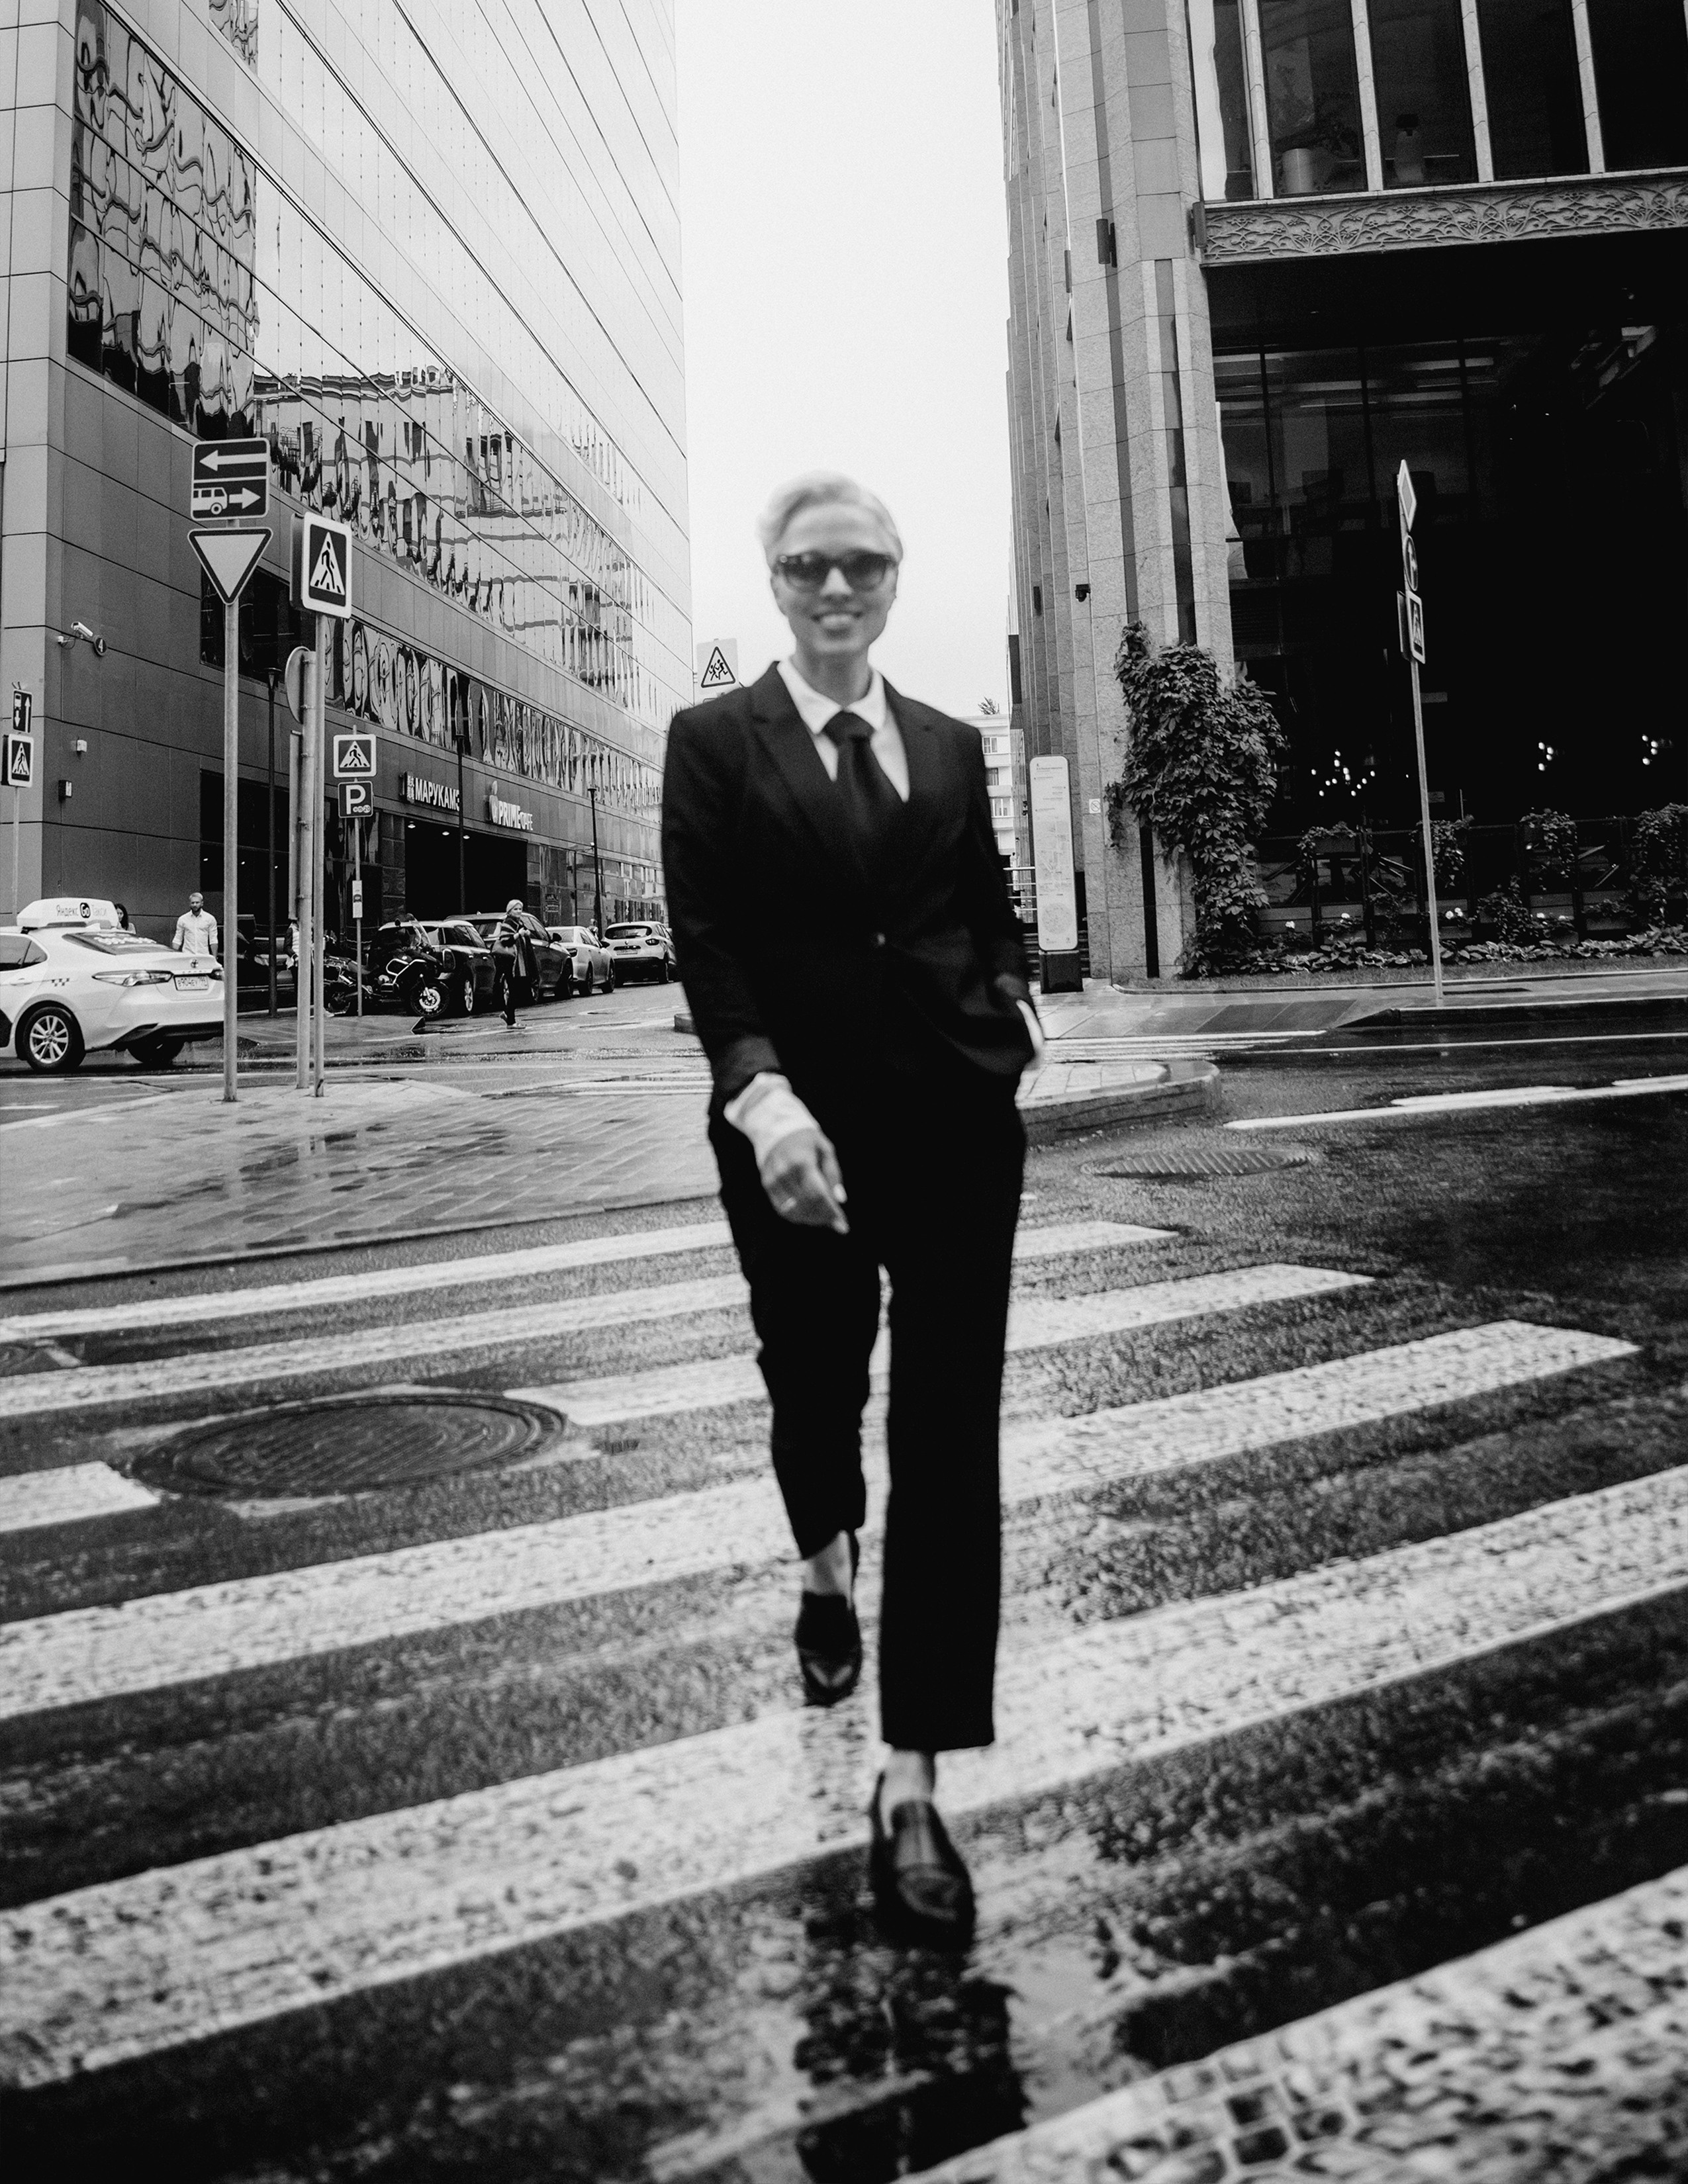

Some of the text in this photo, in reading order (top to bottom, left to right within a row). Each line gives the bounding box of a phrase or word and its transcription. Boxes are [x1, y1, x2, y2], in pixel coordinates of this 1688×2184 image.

[99, 639, 103, 653] 4
[346, 784, 366, 815] P
[498, 800, 521, 829] PRIME
